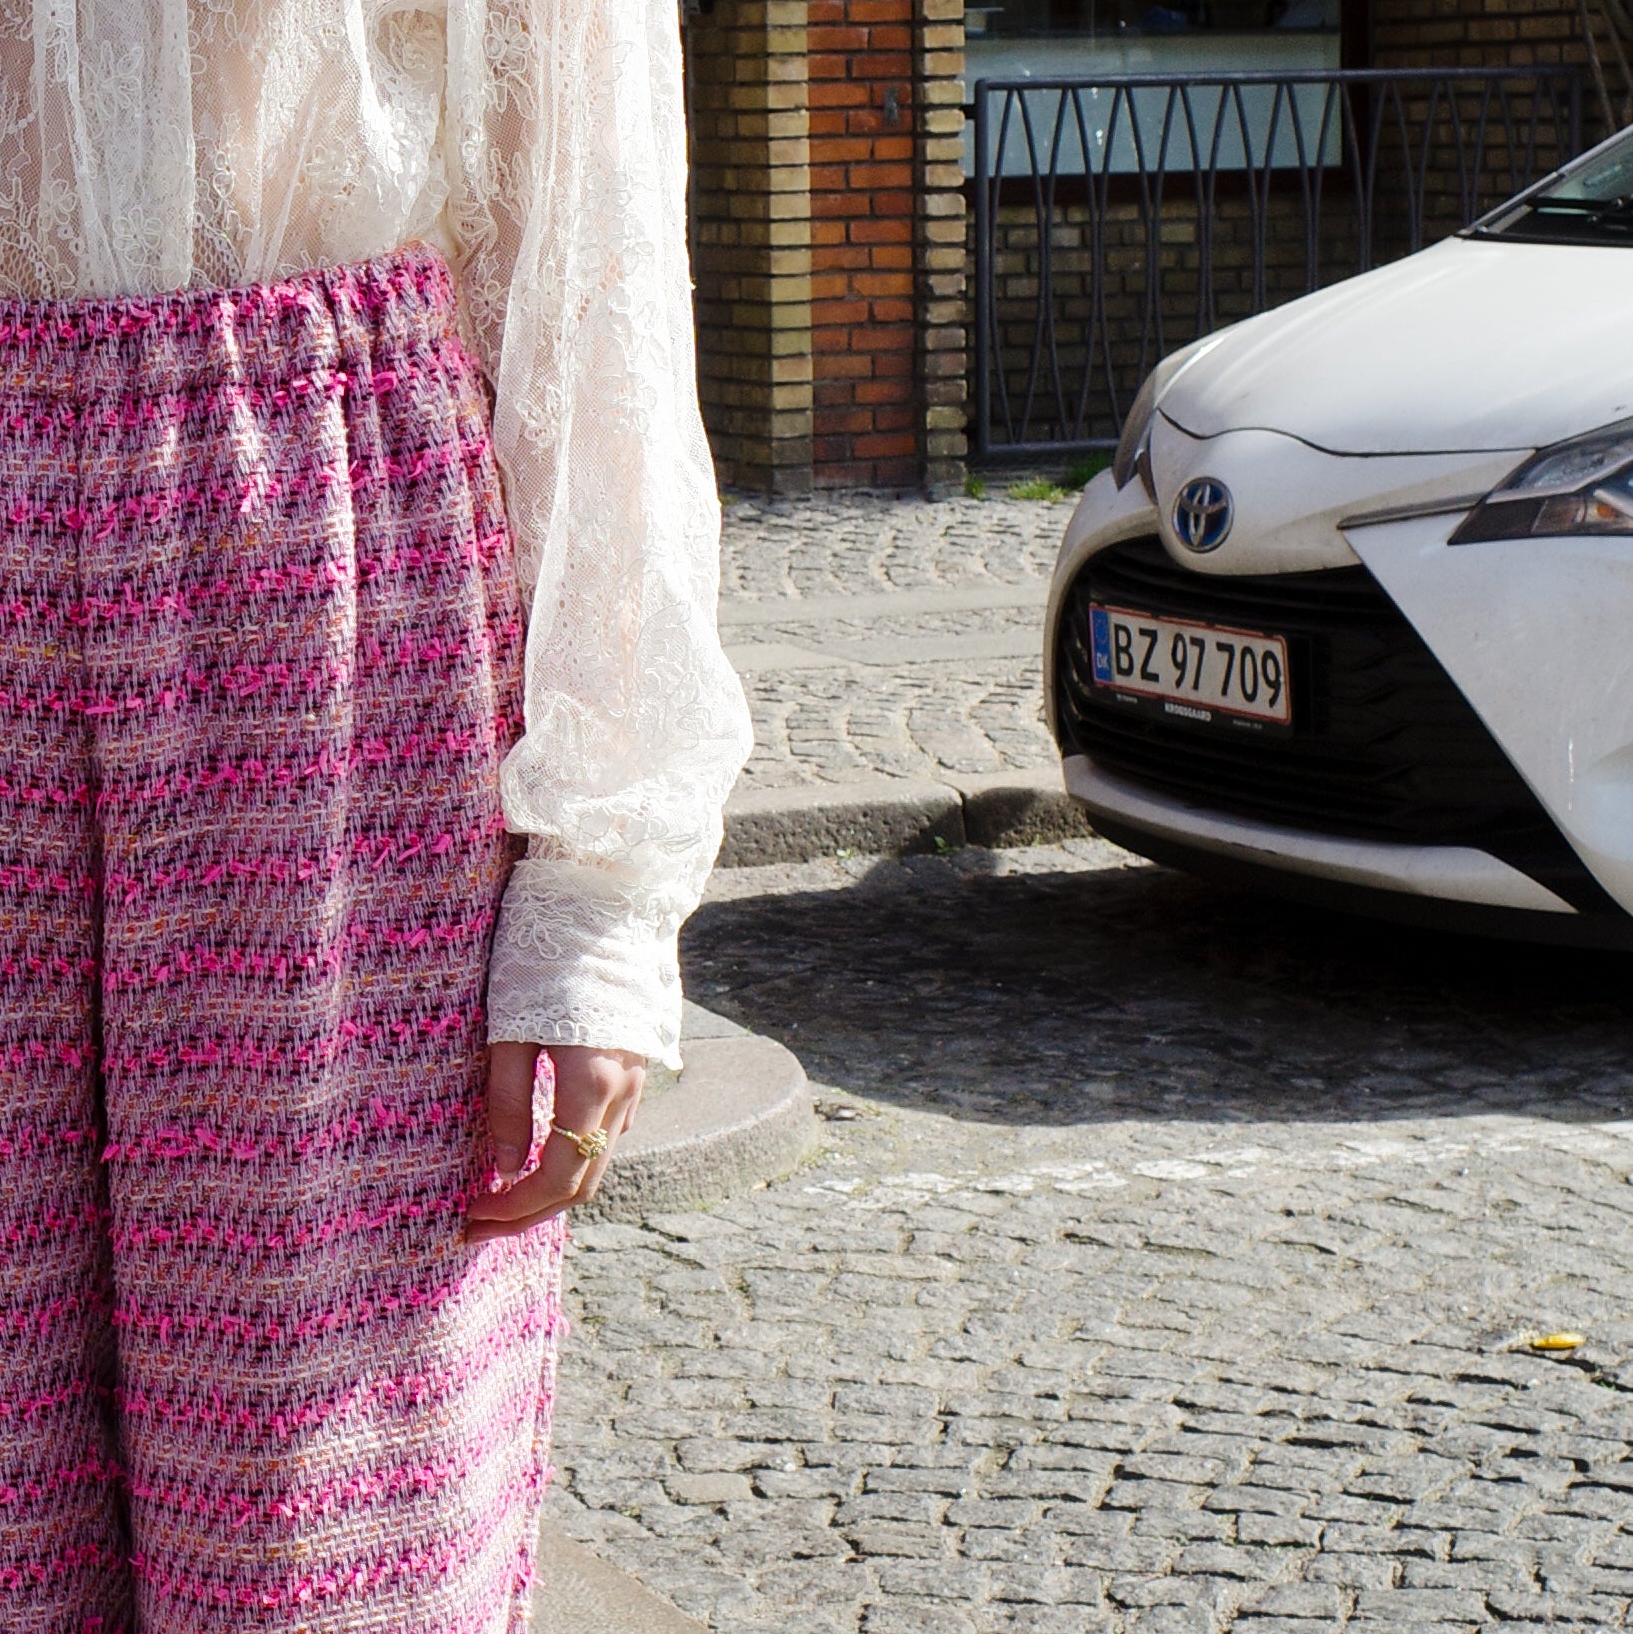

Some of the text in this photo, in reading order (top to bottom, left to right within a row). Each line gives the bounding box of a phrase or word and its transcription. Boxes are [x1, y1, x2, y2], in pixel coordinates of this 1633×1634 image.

[1114, 623, 1282, 709] BZ 97 709
